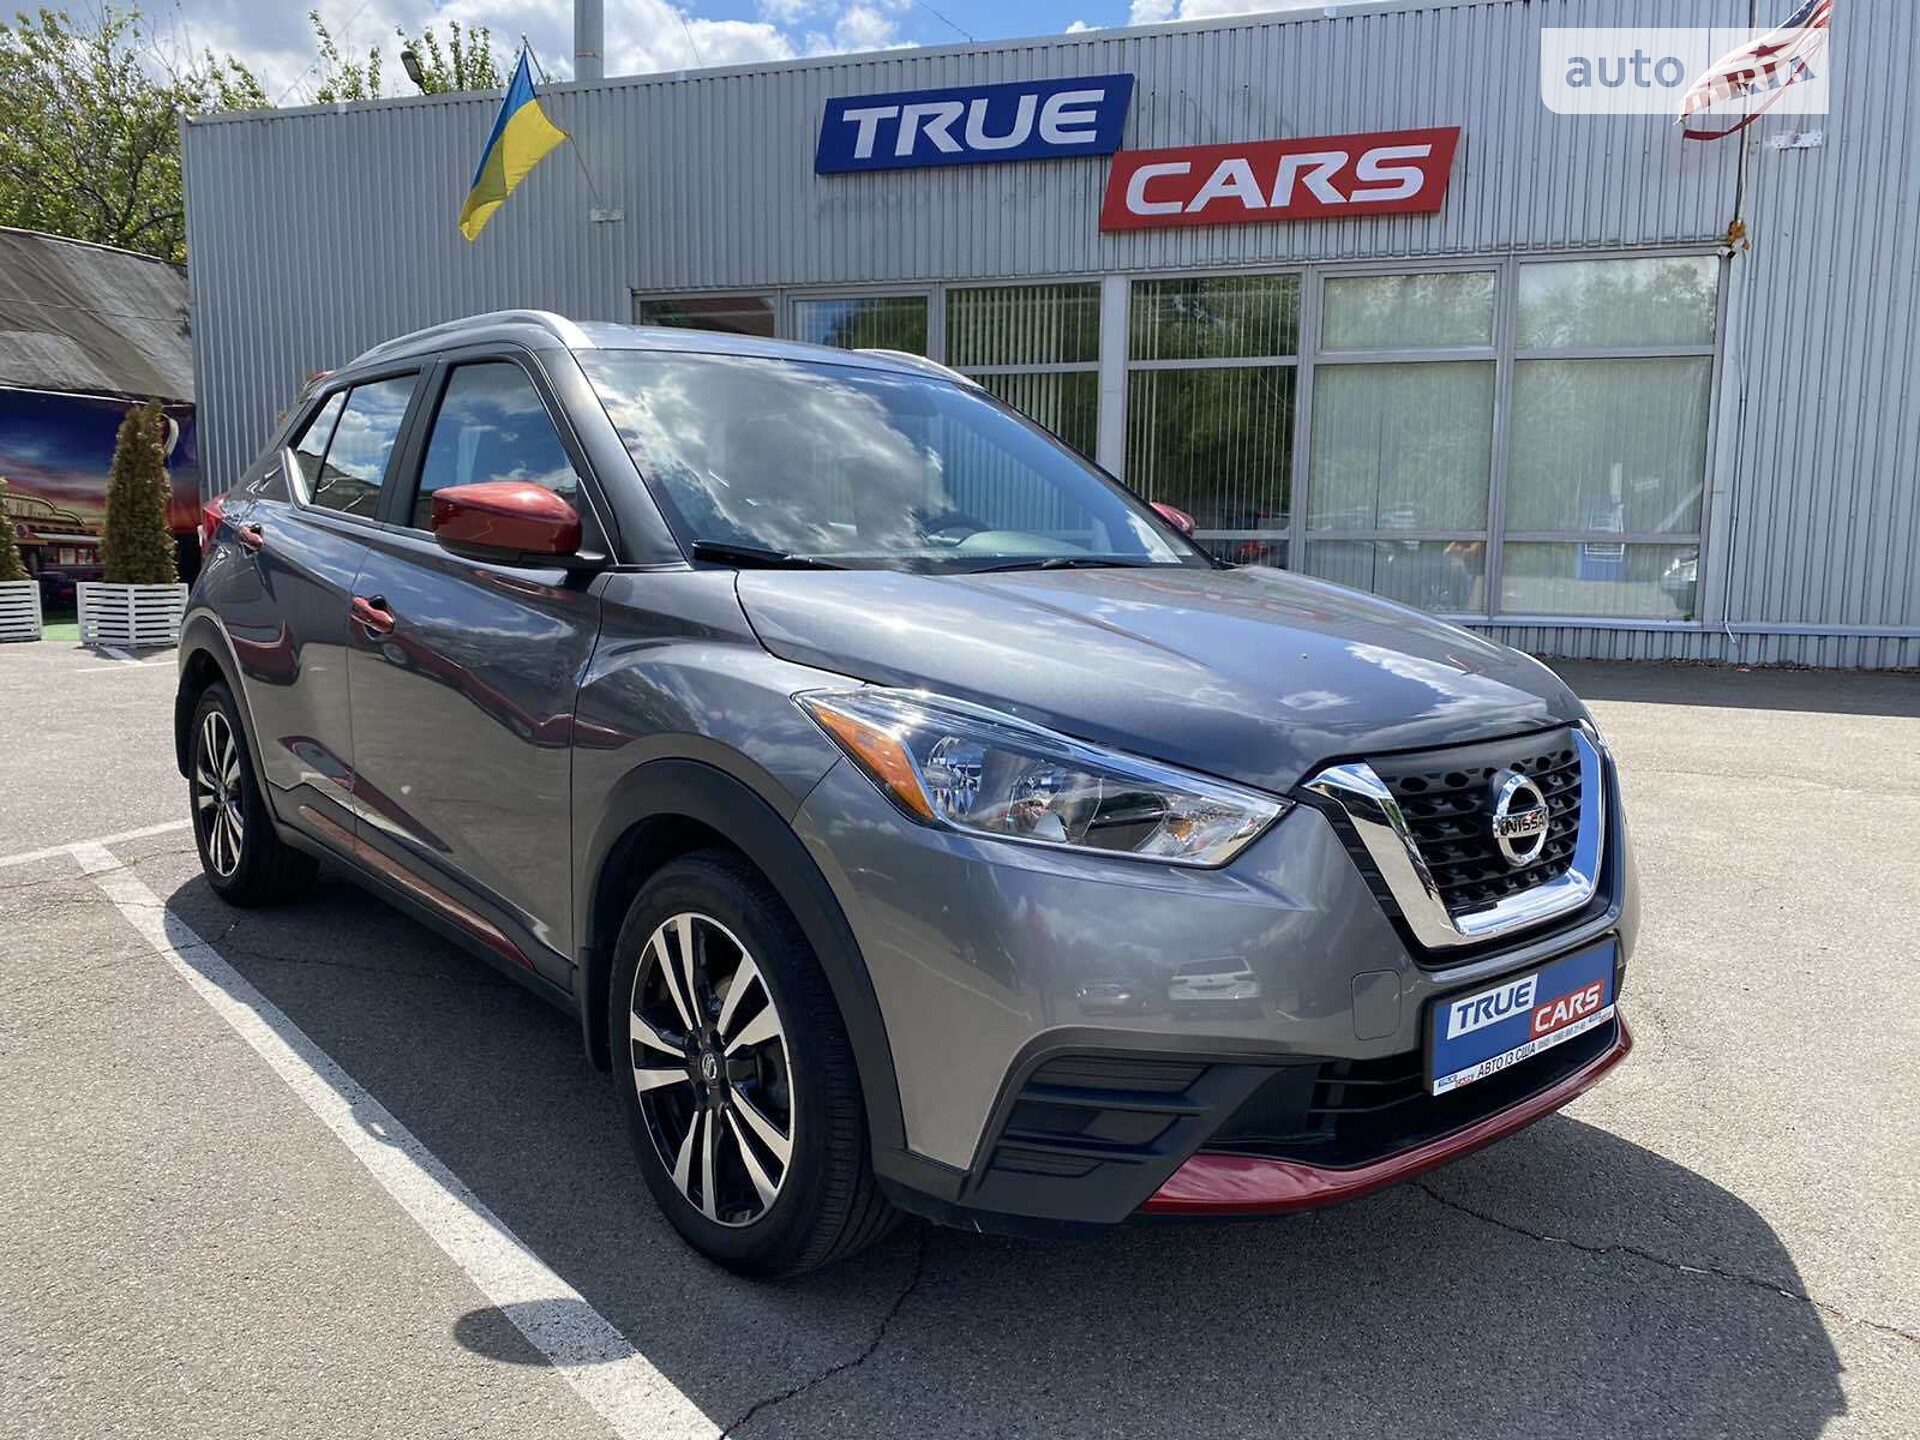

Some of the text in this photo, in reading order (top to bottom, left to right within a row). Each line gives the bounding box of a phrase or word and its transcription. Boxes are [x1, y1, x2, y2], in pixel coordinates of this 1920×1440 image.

[842, 89, 1105, 160] TRUE
[1125, 143, 1433, 216] CARS
[1456, 981, 1532, 1030] TRUE
[1535, 984, 1600, 1033] CARS
[1477, 1056, 1504, 1078] АВТО
